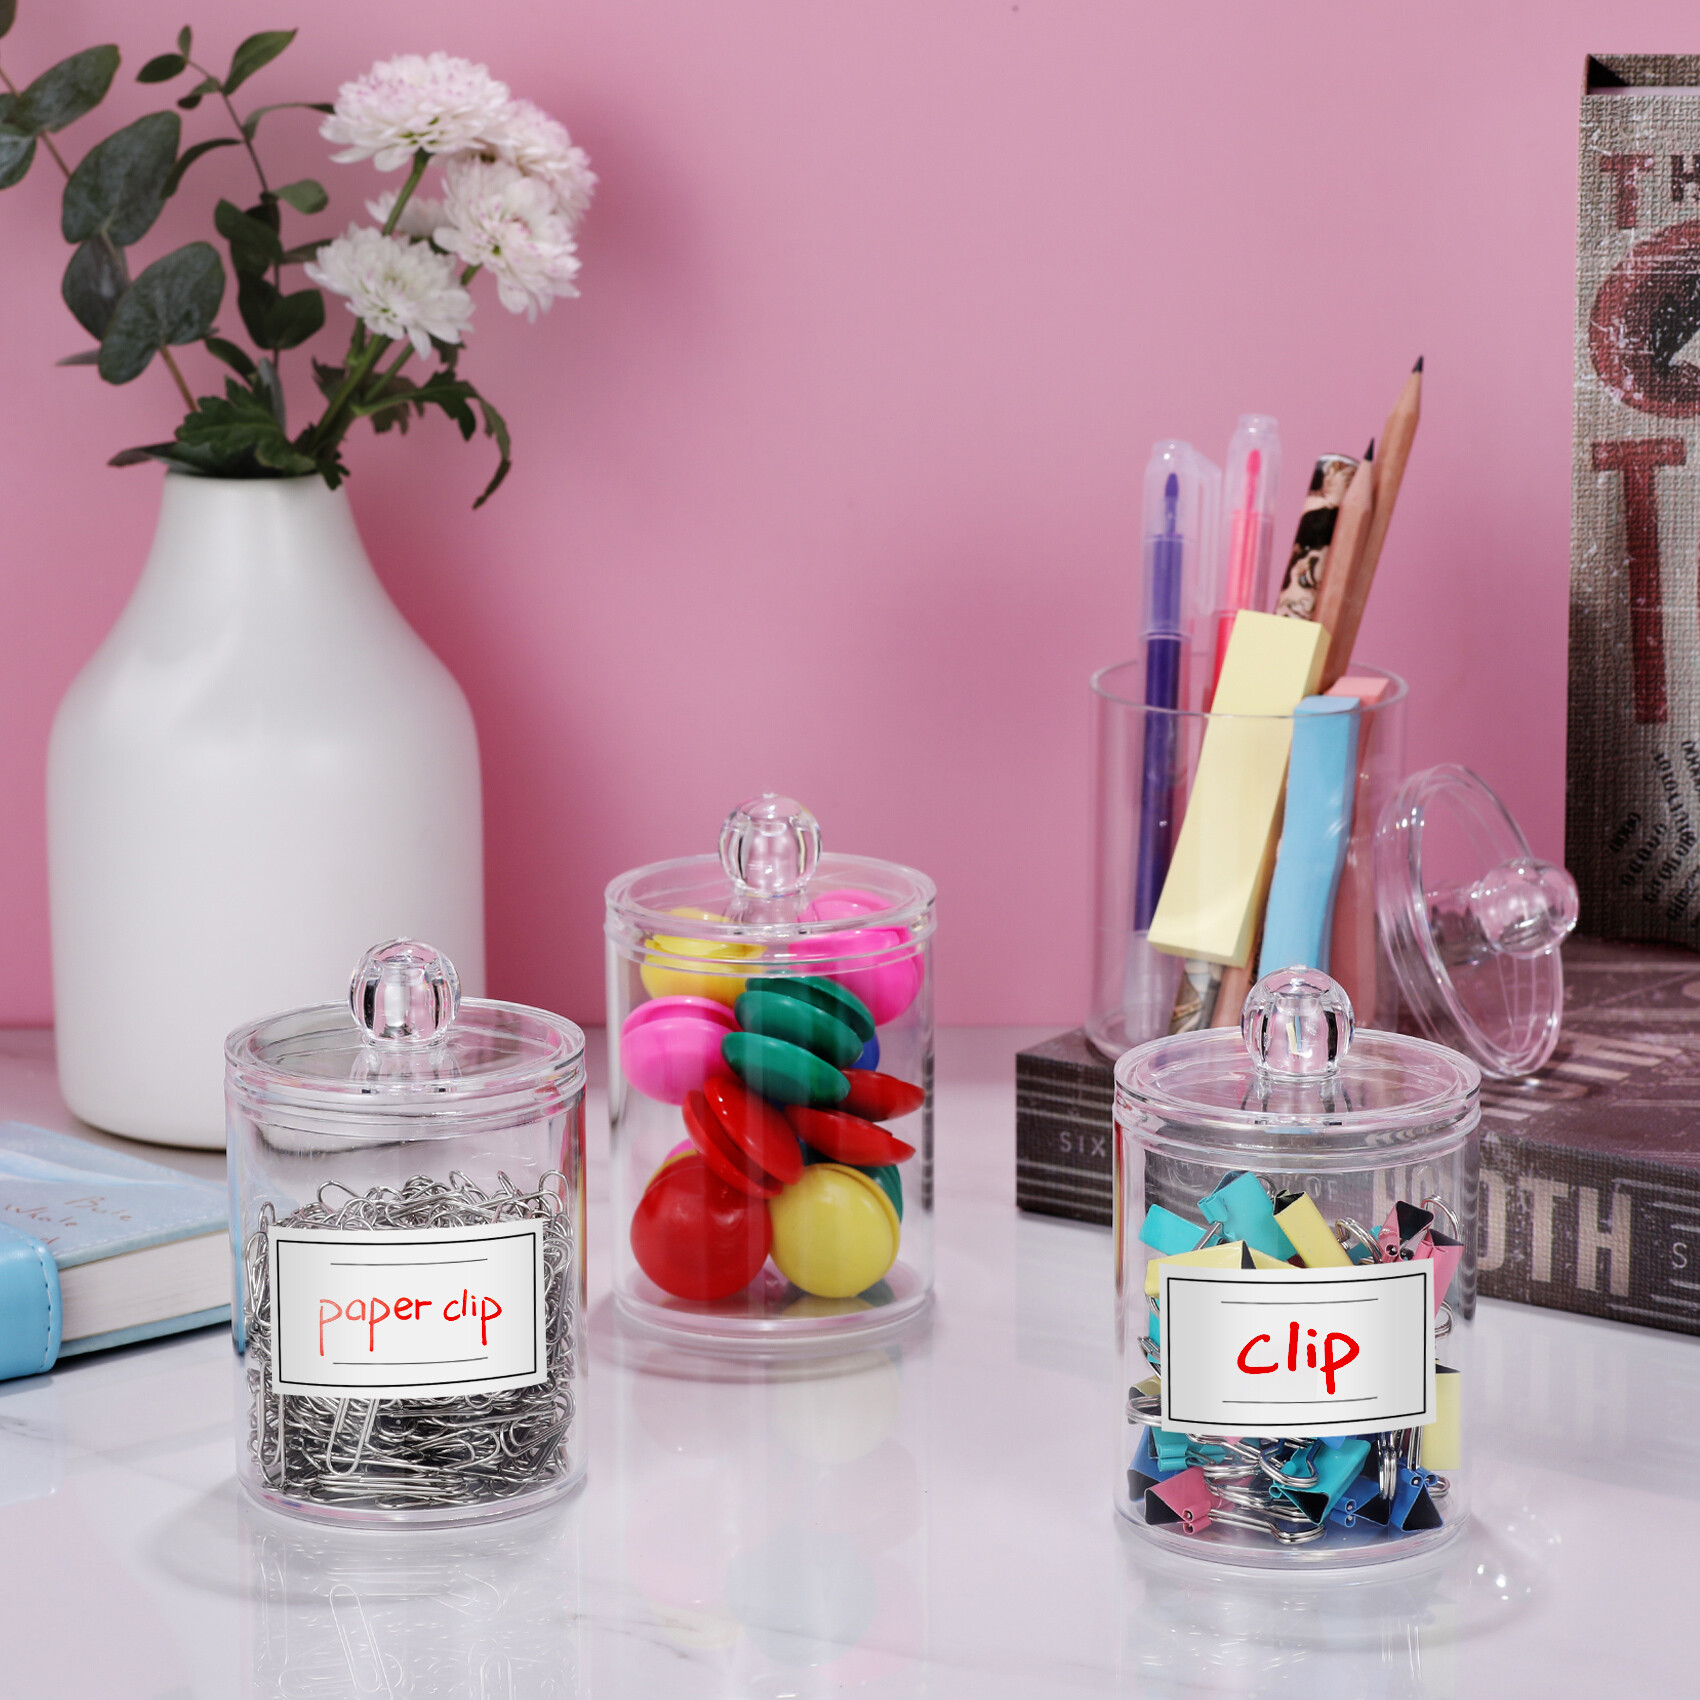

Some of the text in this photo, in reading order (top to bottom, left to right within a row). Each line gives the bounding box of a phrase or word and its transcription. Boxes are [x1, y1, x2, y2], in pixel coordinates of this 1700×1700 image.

[319, 1288, 503, 1357] paper clip
[1236, 1320, 1361, 1396] clip
